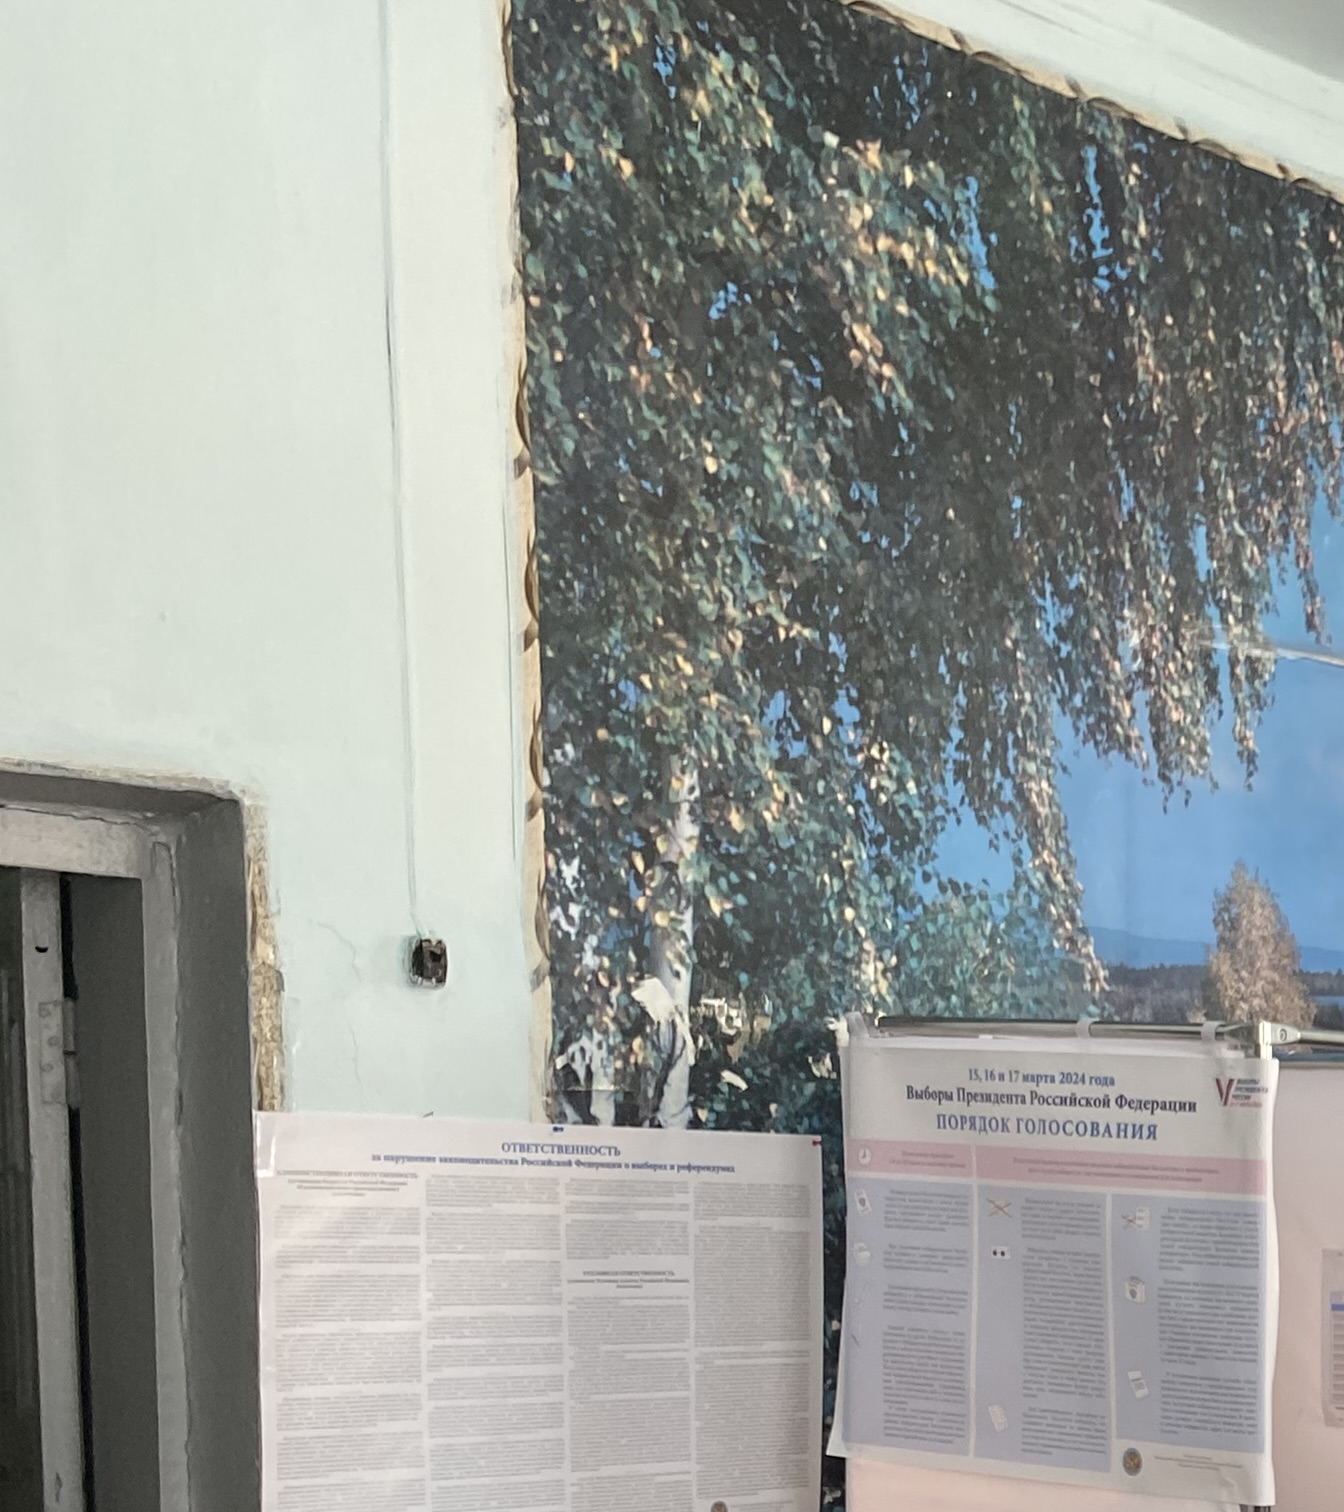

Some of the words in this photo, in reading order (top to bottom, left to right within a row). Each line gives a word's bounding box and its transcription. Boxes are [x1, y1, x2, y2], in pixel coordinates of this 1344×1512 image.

[968, 1068, 982, 1083] 15,
[985, 1069, 996, 1081] 16
[998, 1072, 1005, 1082] и
[1008, 1070, 1019, 1083] 17
[1022, 1073, 1056, 1087] марта
[1059, 1072, 1086, 1085] 2024
[1089, 1076, 1115, 1087] года
[906, 1085, 953, 1105] Выборы
[957, 1087, 1026, 1107] Президента
[1030, 1090, 1111, 1109] Российской
[1115, 1094, 1197, 1115] Федерации
[936, 1114, 1010, 1135] ПОРЯДОК
[1016, 1118, 1158, 1140] ГОЛОСОВАНИЯ
[501, 1142, 621, 1157] ОТВЕТСТВЕННОСТЬ
